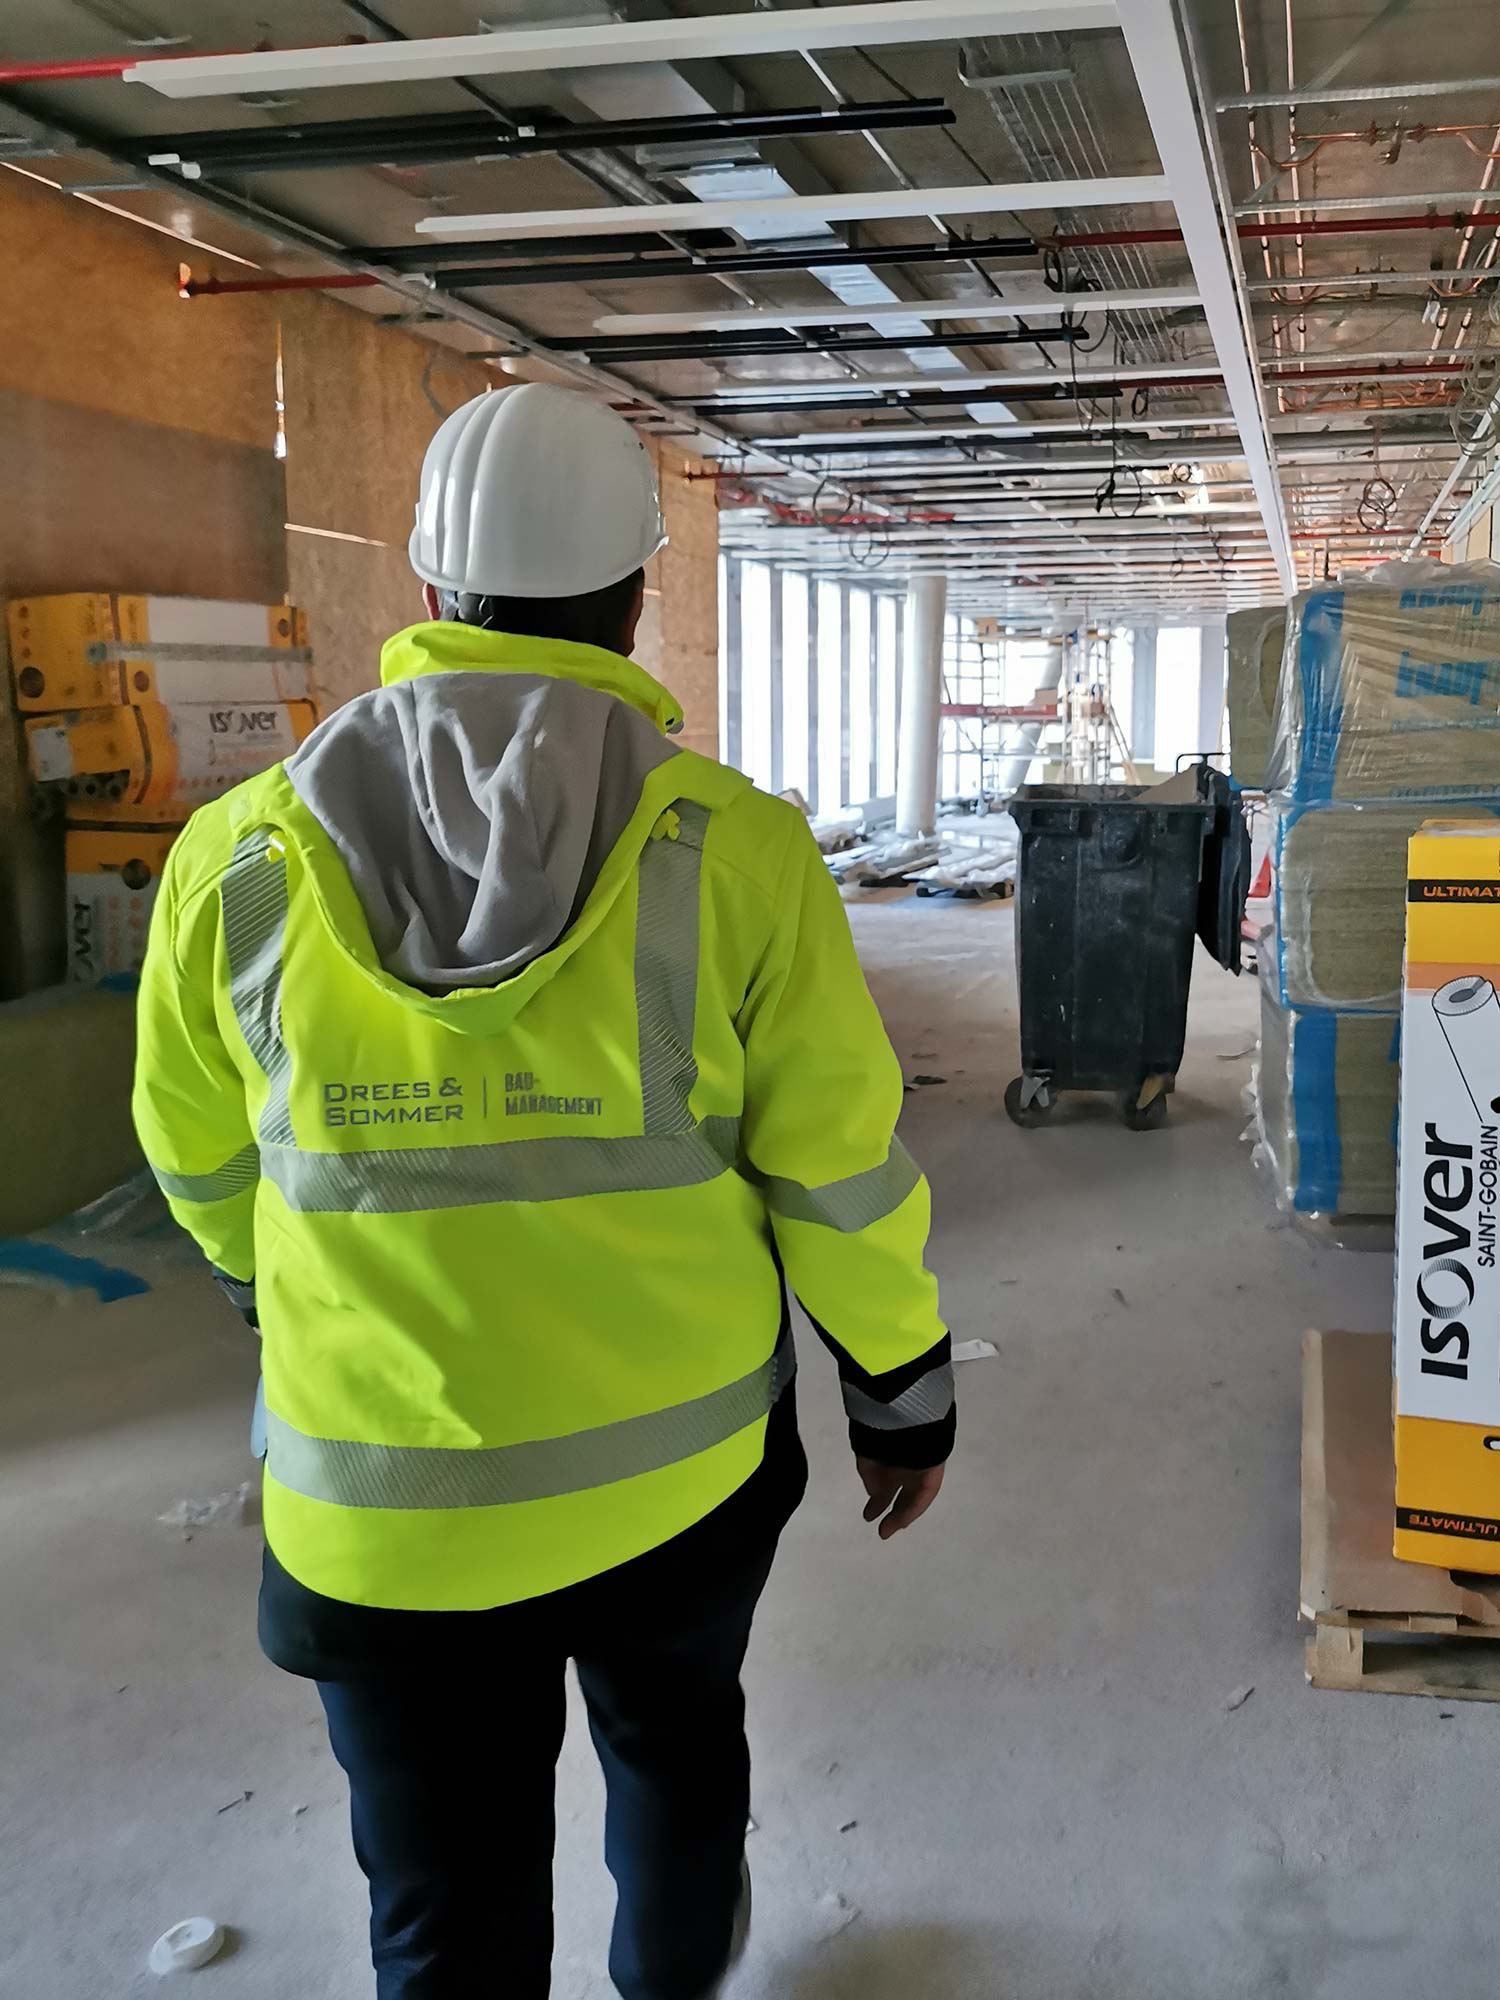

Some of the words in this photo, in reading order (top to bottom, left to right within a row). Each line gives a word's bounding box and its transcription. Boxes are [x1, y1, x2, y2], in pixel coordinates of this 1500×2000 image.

[324, 1081, 430, 1103] DREES
[438, 1077, 463, 1097] &
[505, 1072, 541, 1092] BAU-
[325, 1104, 464, 1127] SOMMER
[505, 1095, 602, 1116] MANAGEMENT
[1477, 1125, 1498, 1268] SAINT-GOBAIN
[1409, 1514, 1498, 1536] ULTIMATE
